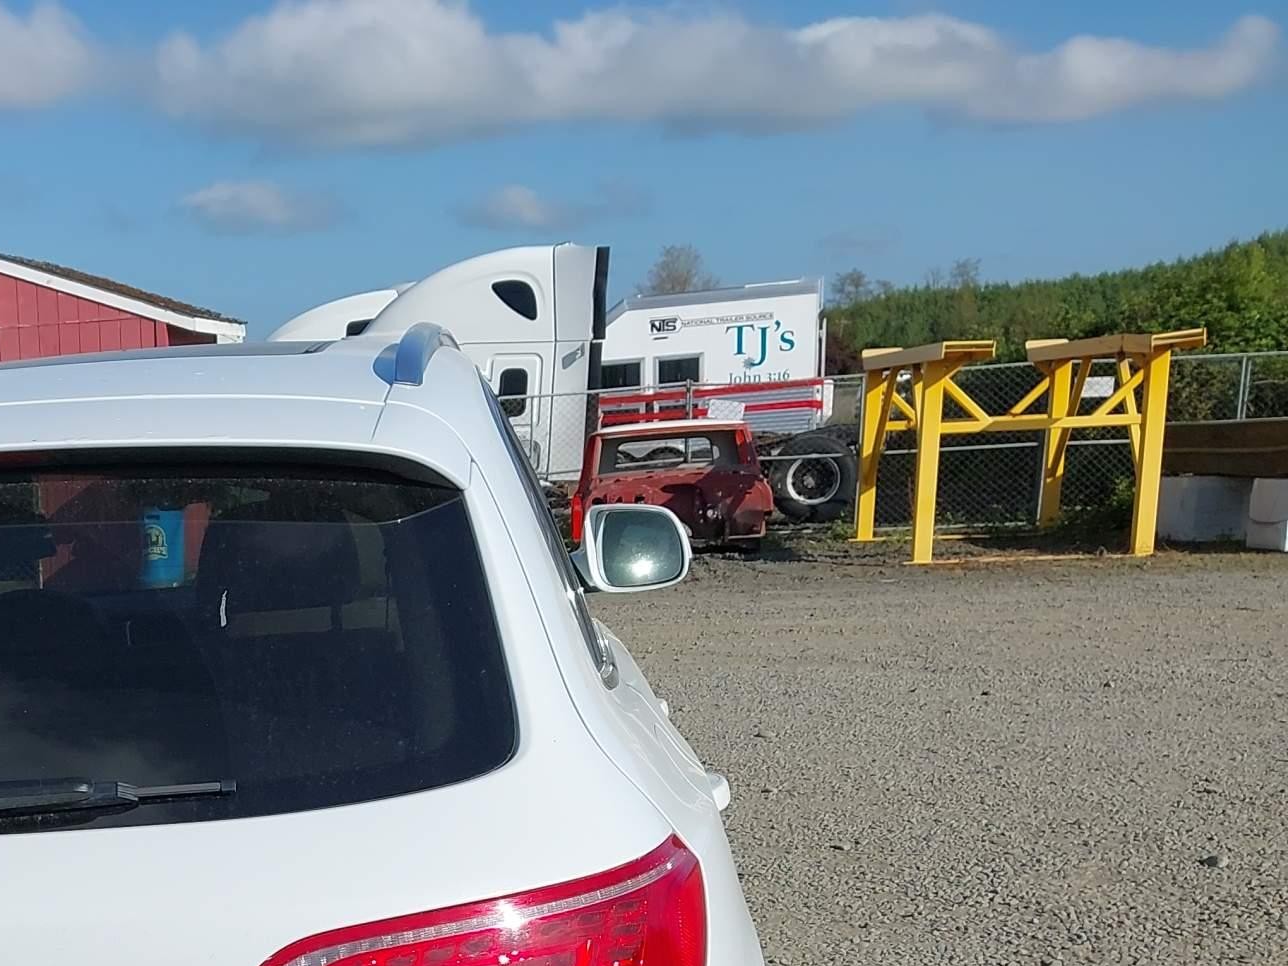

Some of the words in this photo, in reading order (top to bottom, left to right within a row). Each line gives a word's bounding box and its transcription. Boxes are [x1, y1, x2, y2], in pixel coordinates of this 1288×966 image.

[650, 319, 678, 333] NTS
[681, 318, 713, 328] NATIONAL
[715, 314, 744, 324] TRAILER
[746, 312, 774, 321] SOURCE
[725, 320, 795, 367] TJ's
[728, 371, 761, 385] John
